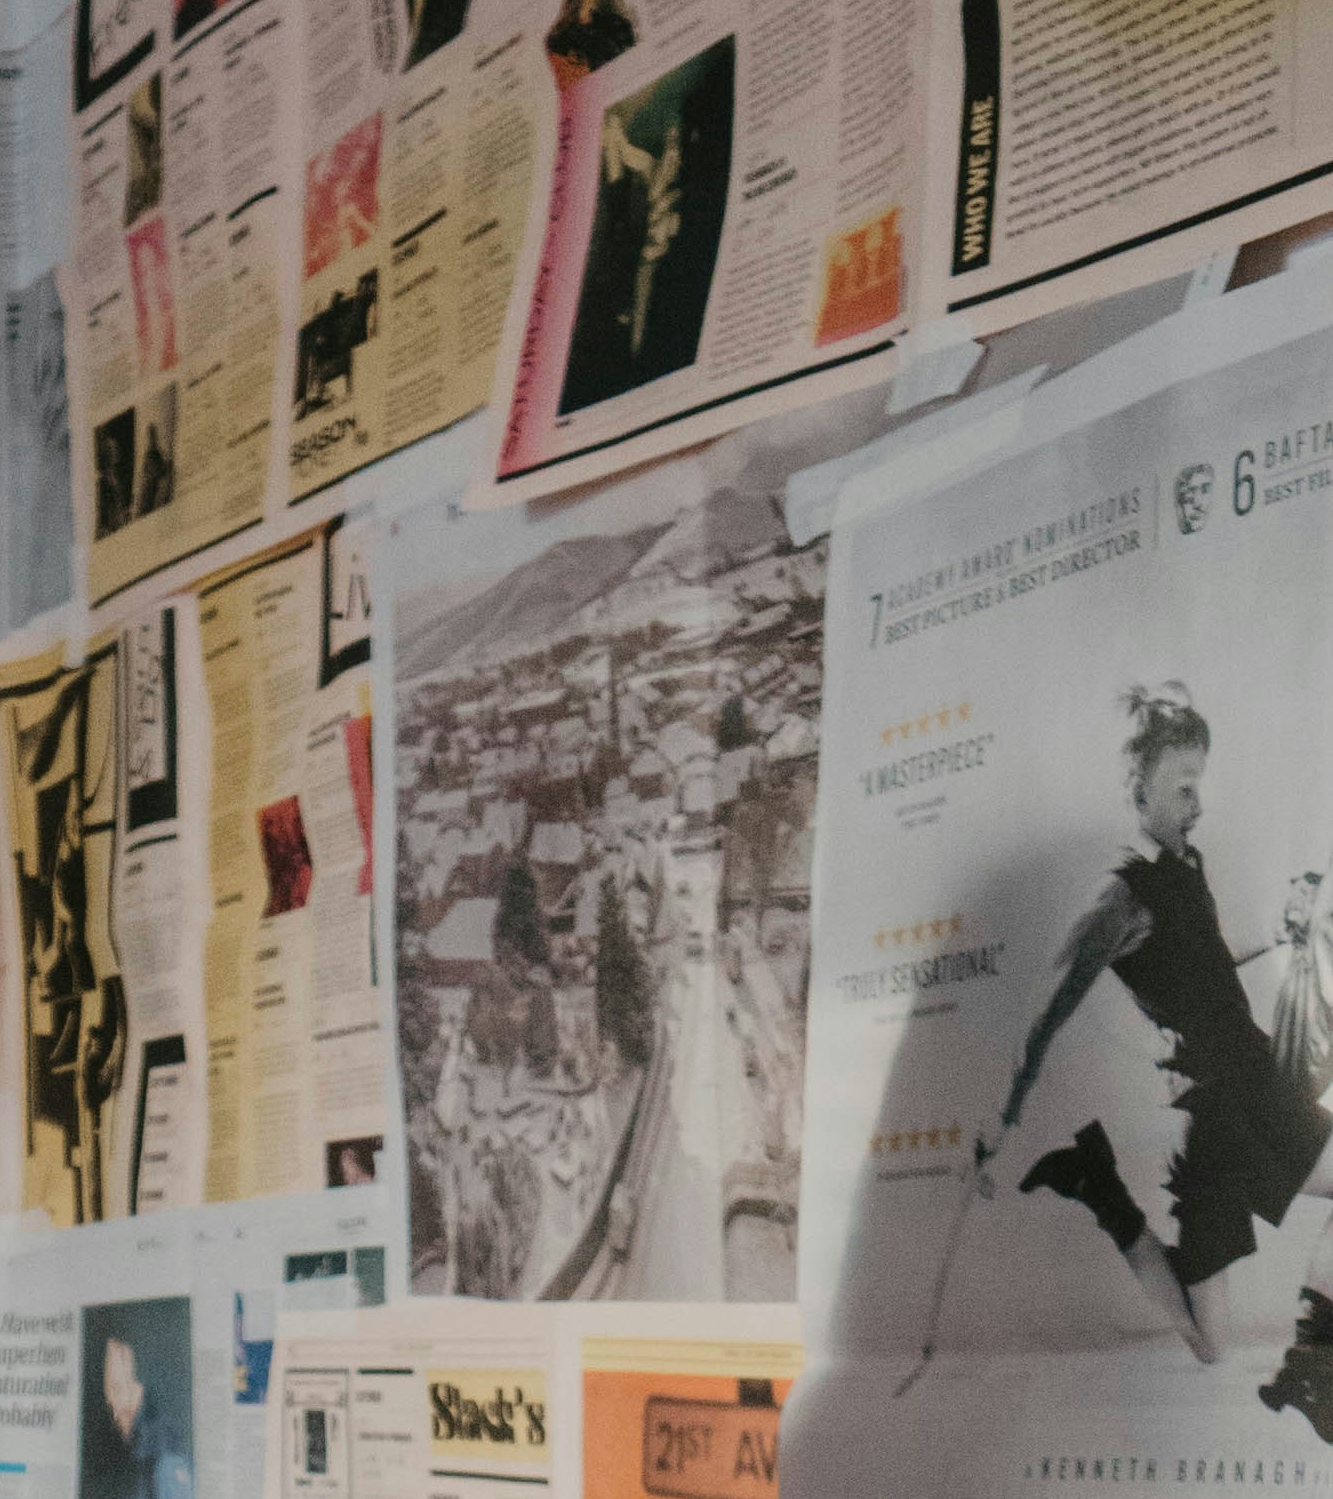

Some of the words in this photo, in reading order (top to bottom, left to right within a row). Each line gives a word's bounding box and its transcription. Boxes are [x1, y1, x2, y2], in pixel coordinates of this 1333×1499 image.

[967, 148, 992, 188] WE
[963, 188, 991, 263] WHO
[1232, 449, 1256, 517] 6
[1263, 475, 1305, 508] BEST
[1021, 486, 1142, 557] NOMINATIONS
[921, 588, 994, 632] PICTURE
[1008, 566, 1048, 600] BEST
[1050, 528, 1142, 584] DIRECTOR
[1039, 1457, 1159, 1484] KENNETH
[1176, 1458, 1307, 1486] BRANAGH
